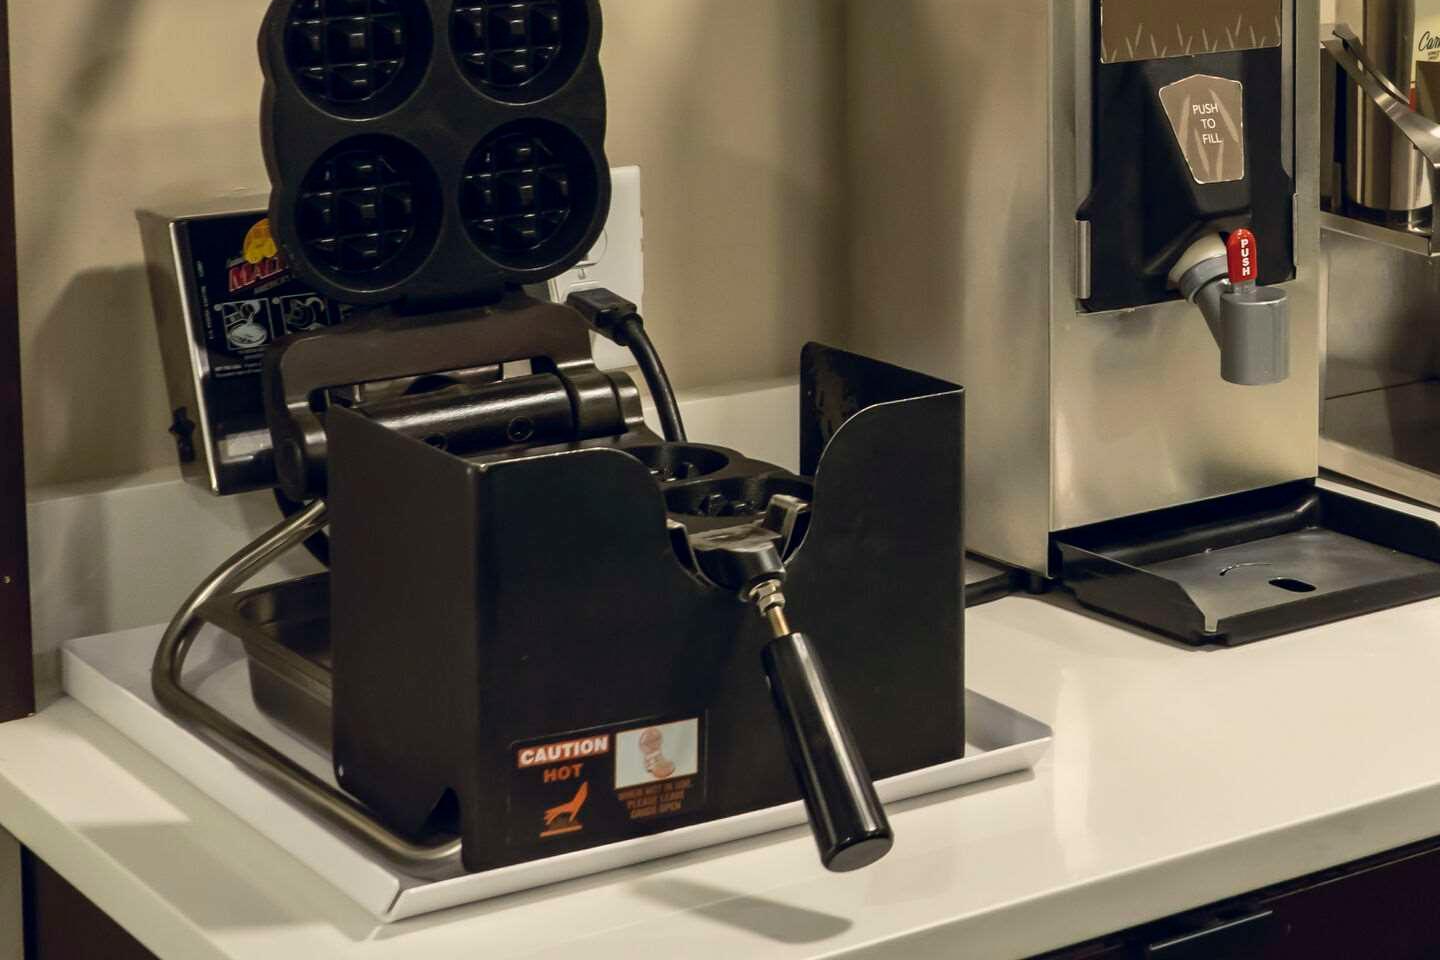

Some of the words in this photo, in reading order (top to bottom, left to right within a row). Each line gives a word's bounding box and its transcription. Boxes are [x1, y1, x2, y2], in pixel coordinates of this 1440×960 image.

[1192, 104, 1219, 115] PUSH
[1200, 118, 1216, 129] TO
[1202, 133, 1223, 144] FILL
[1240, 239, 1250, 276] PUSH
[519, 736, 610, 766] CAUTION
[543, 763, 585, 783] HOT
